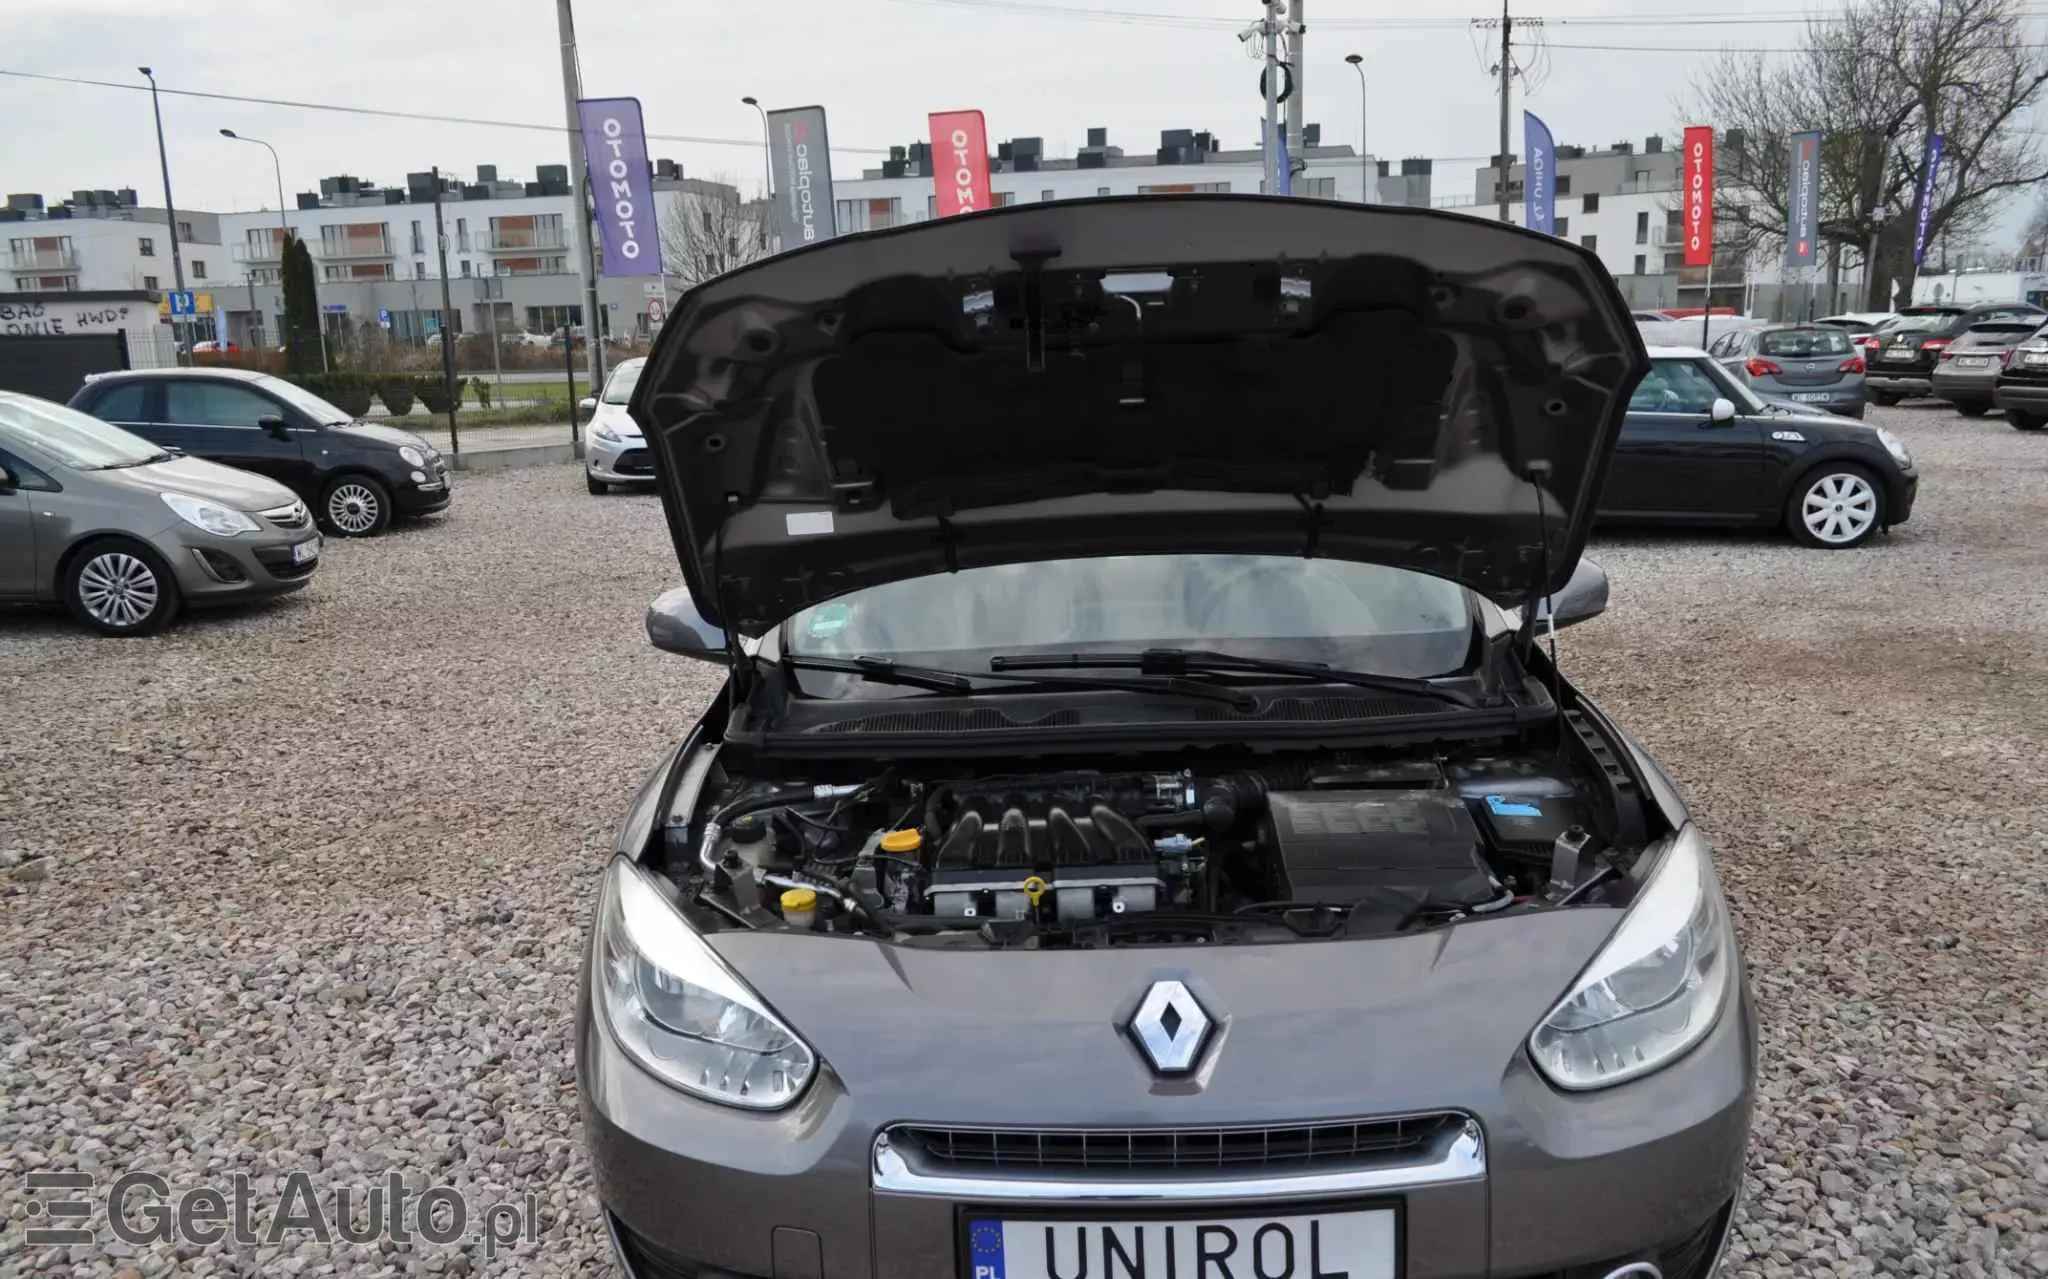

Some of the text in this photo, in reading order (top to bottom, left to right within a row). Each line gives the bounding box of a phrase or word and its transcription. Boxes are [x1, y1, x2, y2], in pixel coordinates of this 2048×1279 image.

[603, 118, 640, 259] OTOMOTO
[1691, 142, 1703, 251] OTOMOTO
[1045, 1219, 1350, 1279] UNIROL
